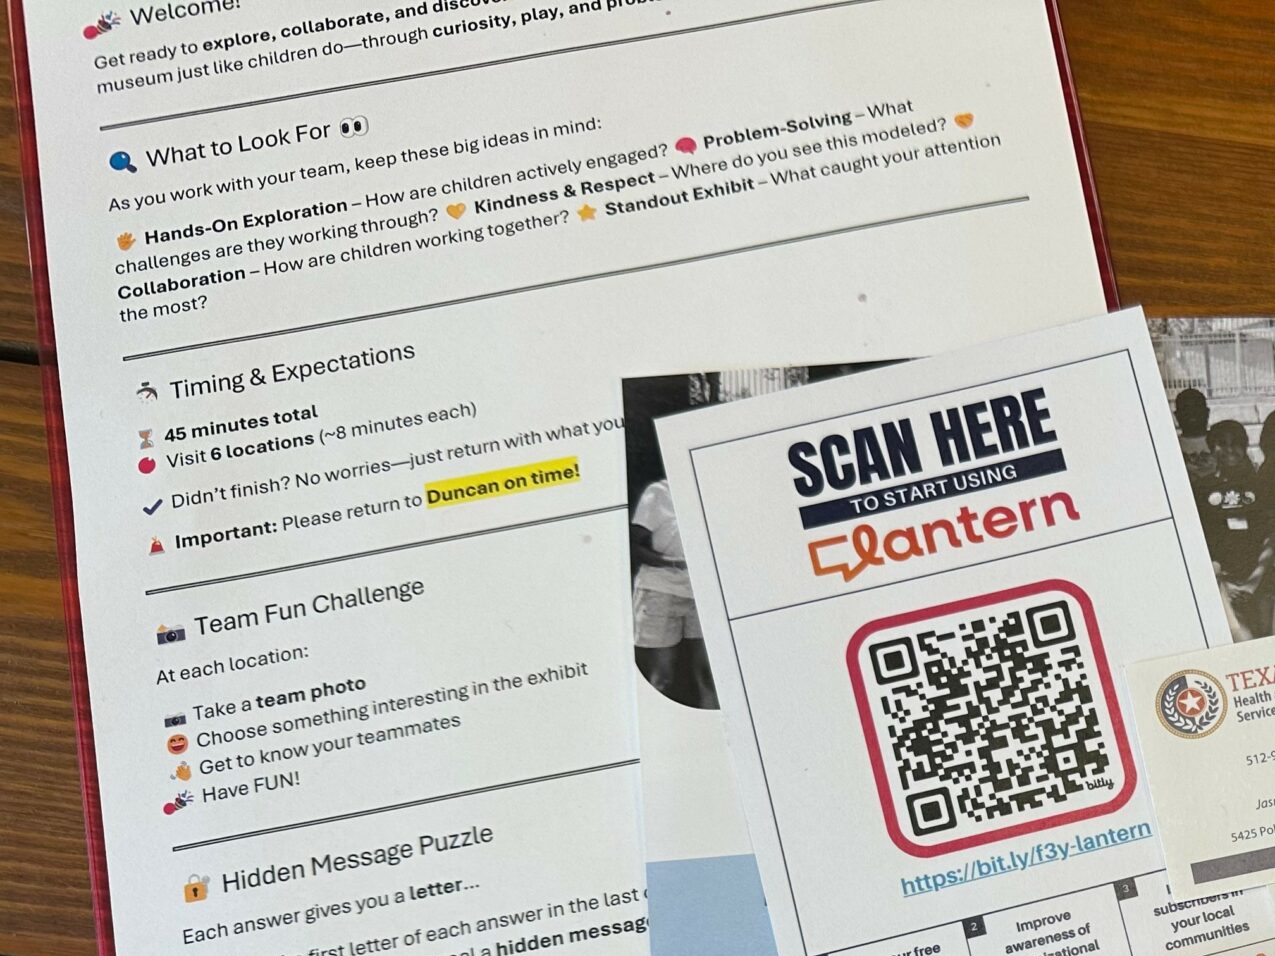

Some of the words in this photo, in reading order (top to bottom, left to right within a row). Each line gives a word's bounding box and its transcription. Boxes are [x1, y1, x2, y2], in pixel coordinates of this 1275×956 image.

[94, 53, 126, 70] Get
[129, 45, 177, 64] ready
[180, 42, 199, 55] to
[202, 31, 277, 52] explore,
[280, 11, 391, 38] collaborate,
[394, 1, 428, 20] and
[145, 143, 207, 168] What
[209, 141, 233, 157] to
[238, 128, 292, 153] Look
[295, 124, 331, 143] For
[169, 372, 246, 399] Timing
[249, 367, 267, 387] &
[271, 345, 416, 383] Expectations
[164, 426, 187, 443] 45
[191, 416, 270, 439] minutes
[272, 404, 319, 425] total
[787, 417, 924, 498] SCAN
[929, 386, 1058, 468] HERE
[175, 521, 278, 550] Important:
[282, 510, 342, 532] Please
[346, 499, 401, 520] return
[403, 495, 423, 509] to
[426, 481, 500, 505] Duncan
[503, 476, 528, 490] on
[530, 463, 580, 485] time!
[849, 495, 879, 514] TO
[883, 479, 948, 507] START
[952, 464, 1018, 491] USING
[851, 491, 1080, 575] lantern
[193, 611, 259, 636] Team
[264, 602, 307, 624] Fun
[312, 580, 425, 614] Challenge
[1233, 689, 1273, 709] Health
[202, 783, 249, 803] Have
[253, 770, 300, 794] FUN!
[1087, 774, 1114, 792] bitly
[222, 863, 306, 894] Hidden
[310, 843, 414, 876] Message
[418, 825, 494, 856] Puzzle
[900, 819, 1152, 899] https://bit.ly/f3y-lantern
[1005, 929, 1077, 955] awareness
[1077, 922, 1091, 936] of
[1015, 911, 1072, 933] Improve
